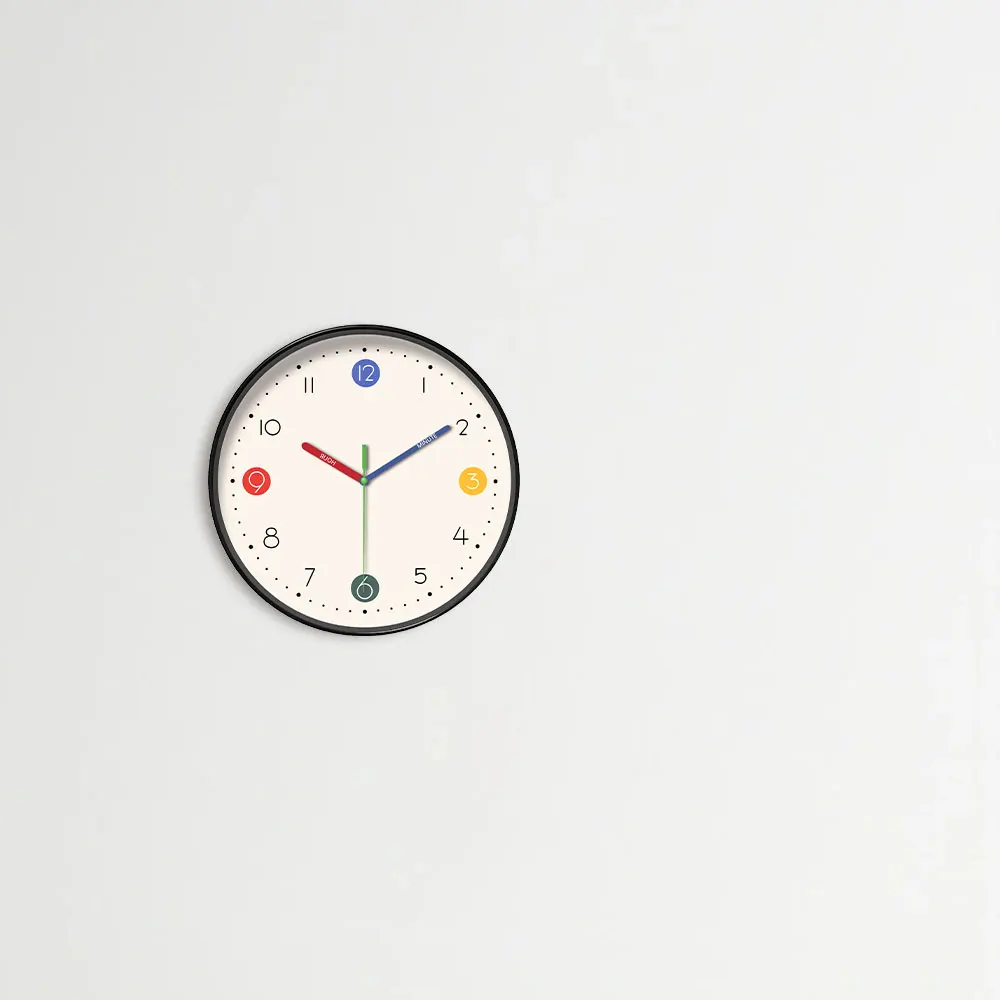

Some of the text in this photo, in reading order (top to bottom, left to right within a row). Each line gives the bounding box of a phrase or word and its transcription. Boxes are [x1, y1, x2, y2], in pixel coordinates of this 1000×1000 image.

[357, 365, 374, 382] 12
[304, 377, 314, 393] 11
[259, 418, 281, 436] 10
[456, 418, 469, 436] 2
[248, 470, 266, 493] 9
[467, 473, 480, 490] 3
[262, 527, 280, 549] 8
[452, 526, 469, 546] 4
[304, 567, 316, 587] 7
[414, 567, 427, 585] 5
[356, 576, 374, 600] 6
